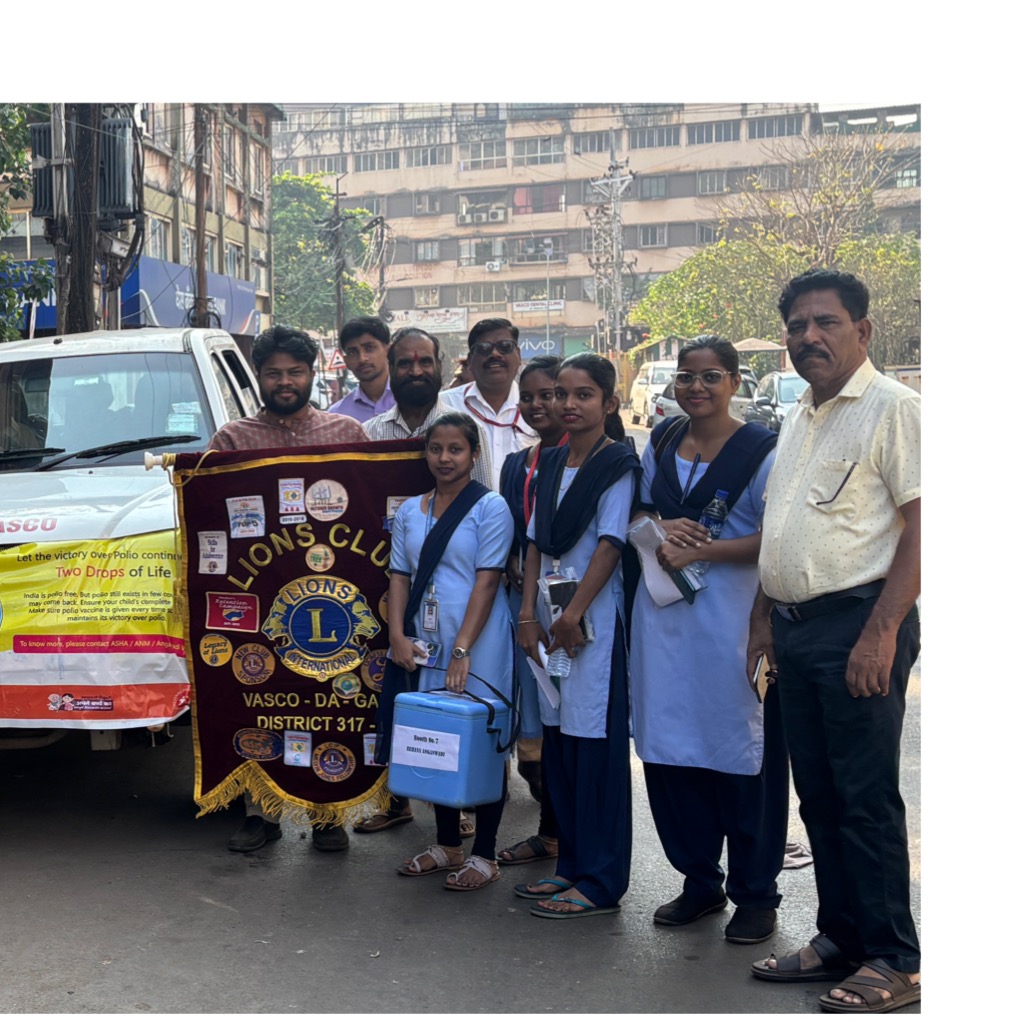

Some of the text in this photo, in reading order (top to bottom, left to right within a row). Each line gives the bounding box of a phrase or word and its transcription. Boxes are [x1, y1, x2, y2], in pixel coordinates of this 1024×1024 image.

[17, 554, 32, 562] Let
[35, 552, 51, 561] the
[55, 550, 88, 560] victory
[113, 550, 139, 560] Polio
[227, 523, 391, 591] LIONS CLU
[55, 565, 172, 580] Two Drops of Life
[285, 579, 352, 602] LIONS
[306, 608, 337, 643] L
[65, 640, 86, 648] please
[235, 645, 270, 659] NEW CLUB
[289, 652, 355, 672] INTERNATIONAL
[238, 669, 272, 683] SPONSOR
[242, 692, 300, 708] VASCO
[314, 692, 340, 708] DA
[257, 716, 333, 731] DISTRICT
[337, 717, 365, 732] 317
